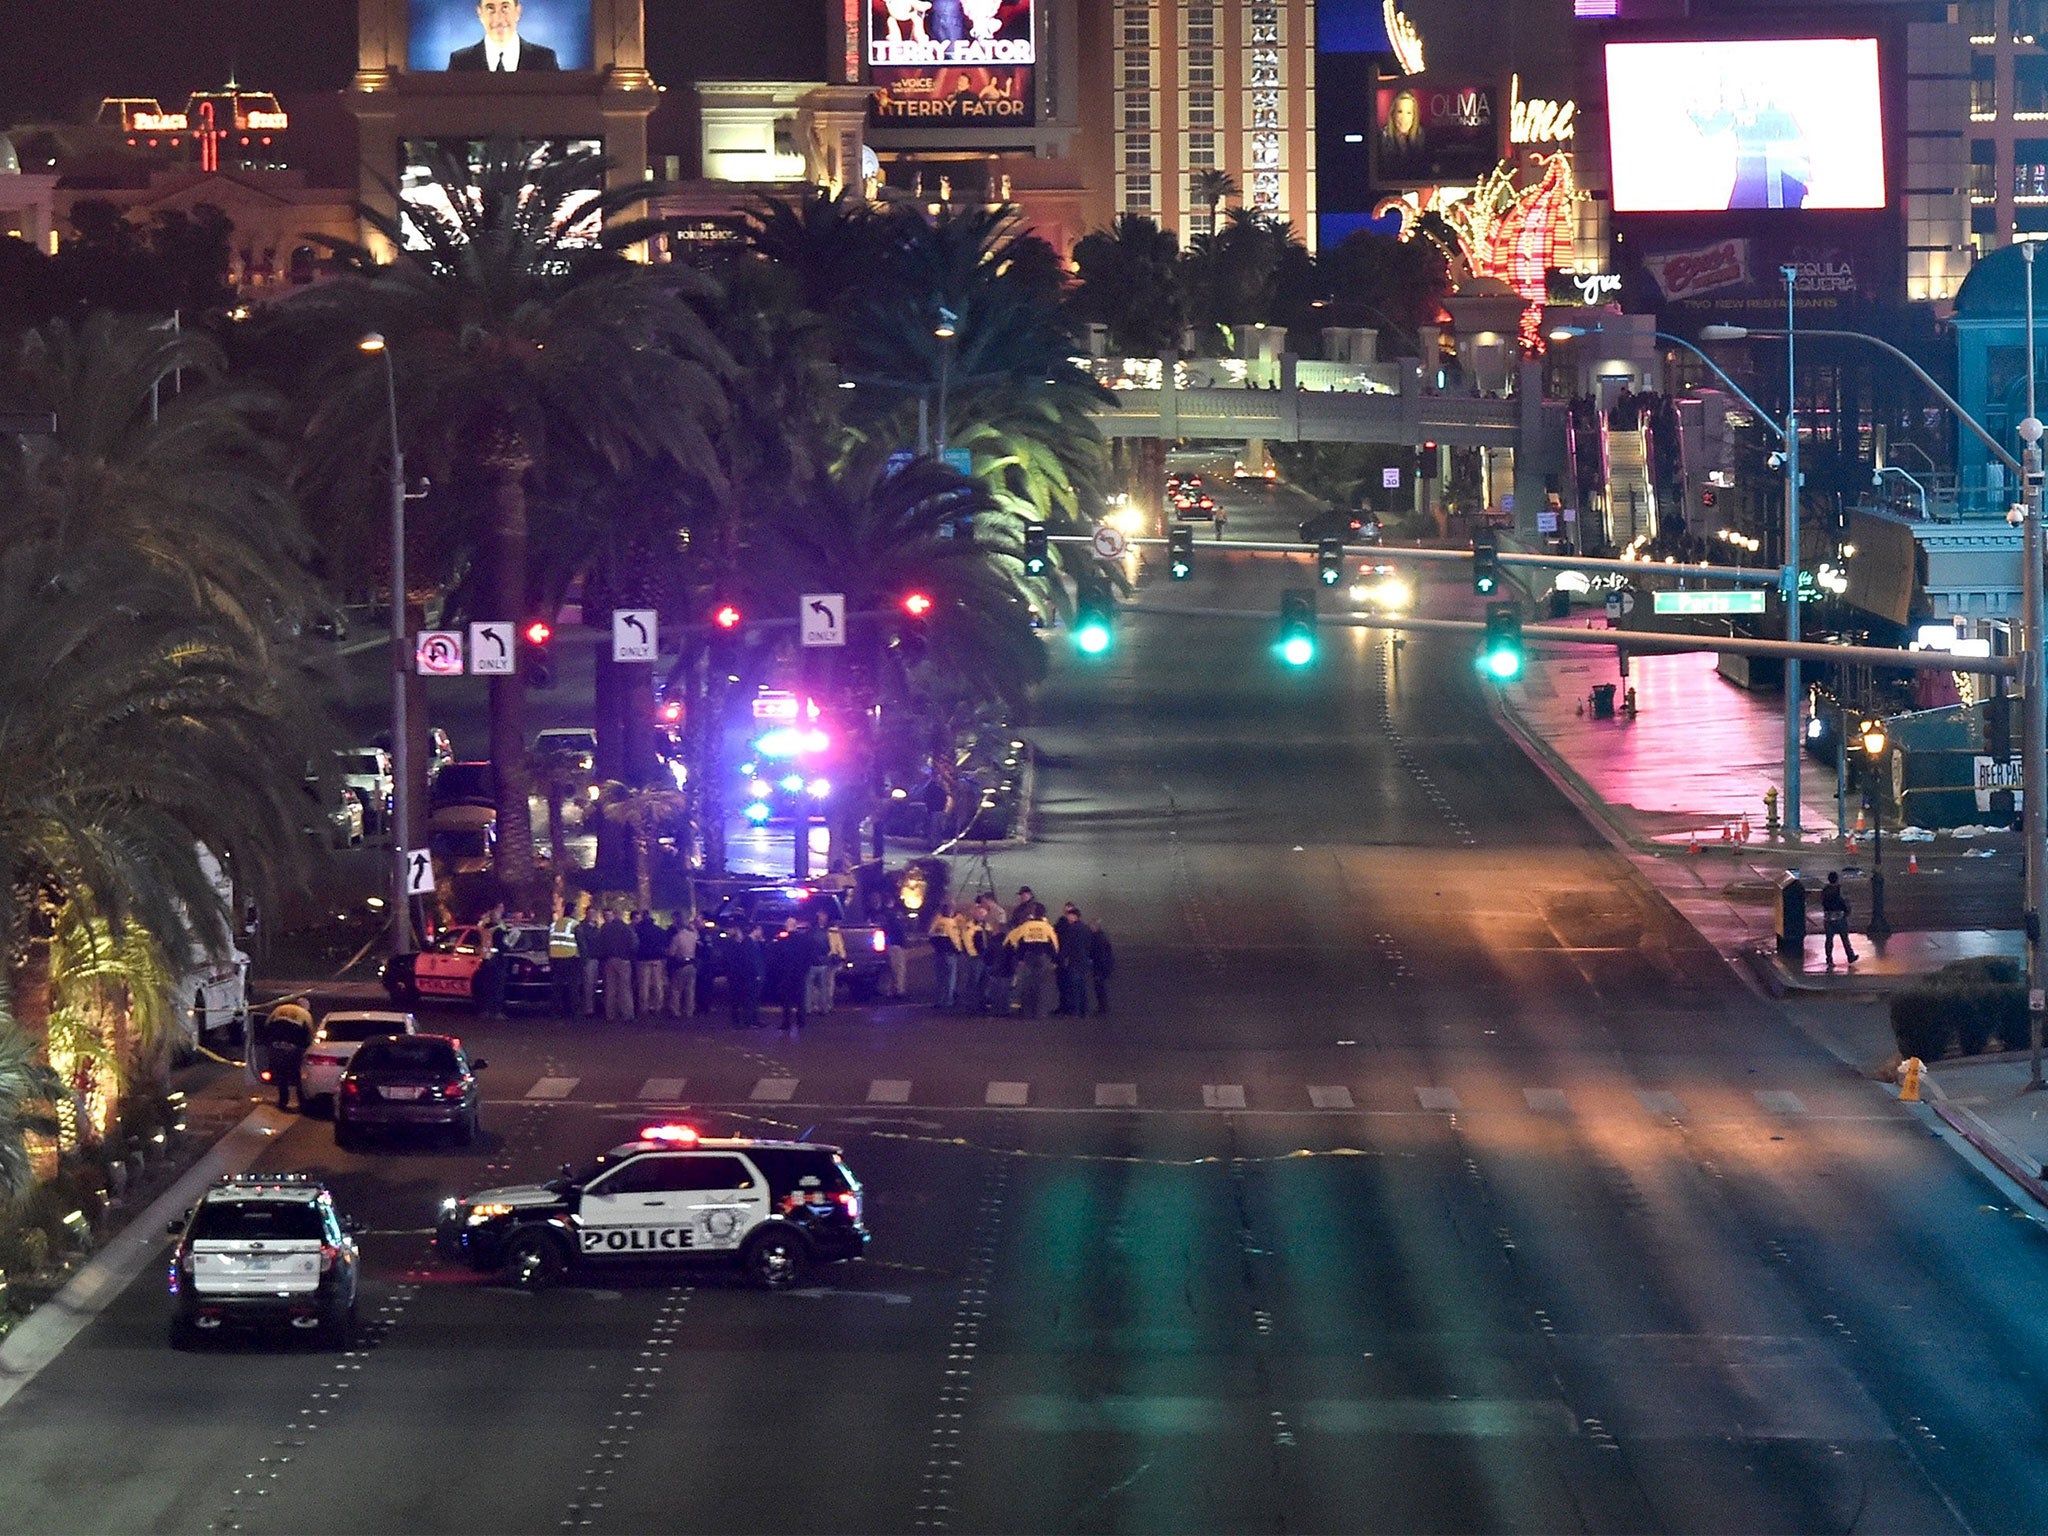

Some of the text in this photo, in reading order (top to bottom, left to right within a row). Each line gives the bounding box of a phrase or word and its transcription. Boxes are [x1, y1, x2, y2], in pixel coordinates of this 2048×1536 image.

[872, 39, 1031, 61] TERRY FATOR
[901, 78, 933, 88] VOICE
[894, 100, 1025, 117] TERRY FATOR
[677, 230, 709, 240] FORUM
[1683, 298, 1838, 309] TWO NEW RESTARANTS
[1678, 592, 1730, 611] Paris
[807, 630, 838, 641] ONLY
[620, 647, 649, 657] ONLY
[478, 659, 508, 670] ONLY
[1980, 763, 2023, 789] BEER PAR
[584, 1229, 693, 1250] POLICE
